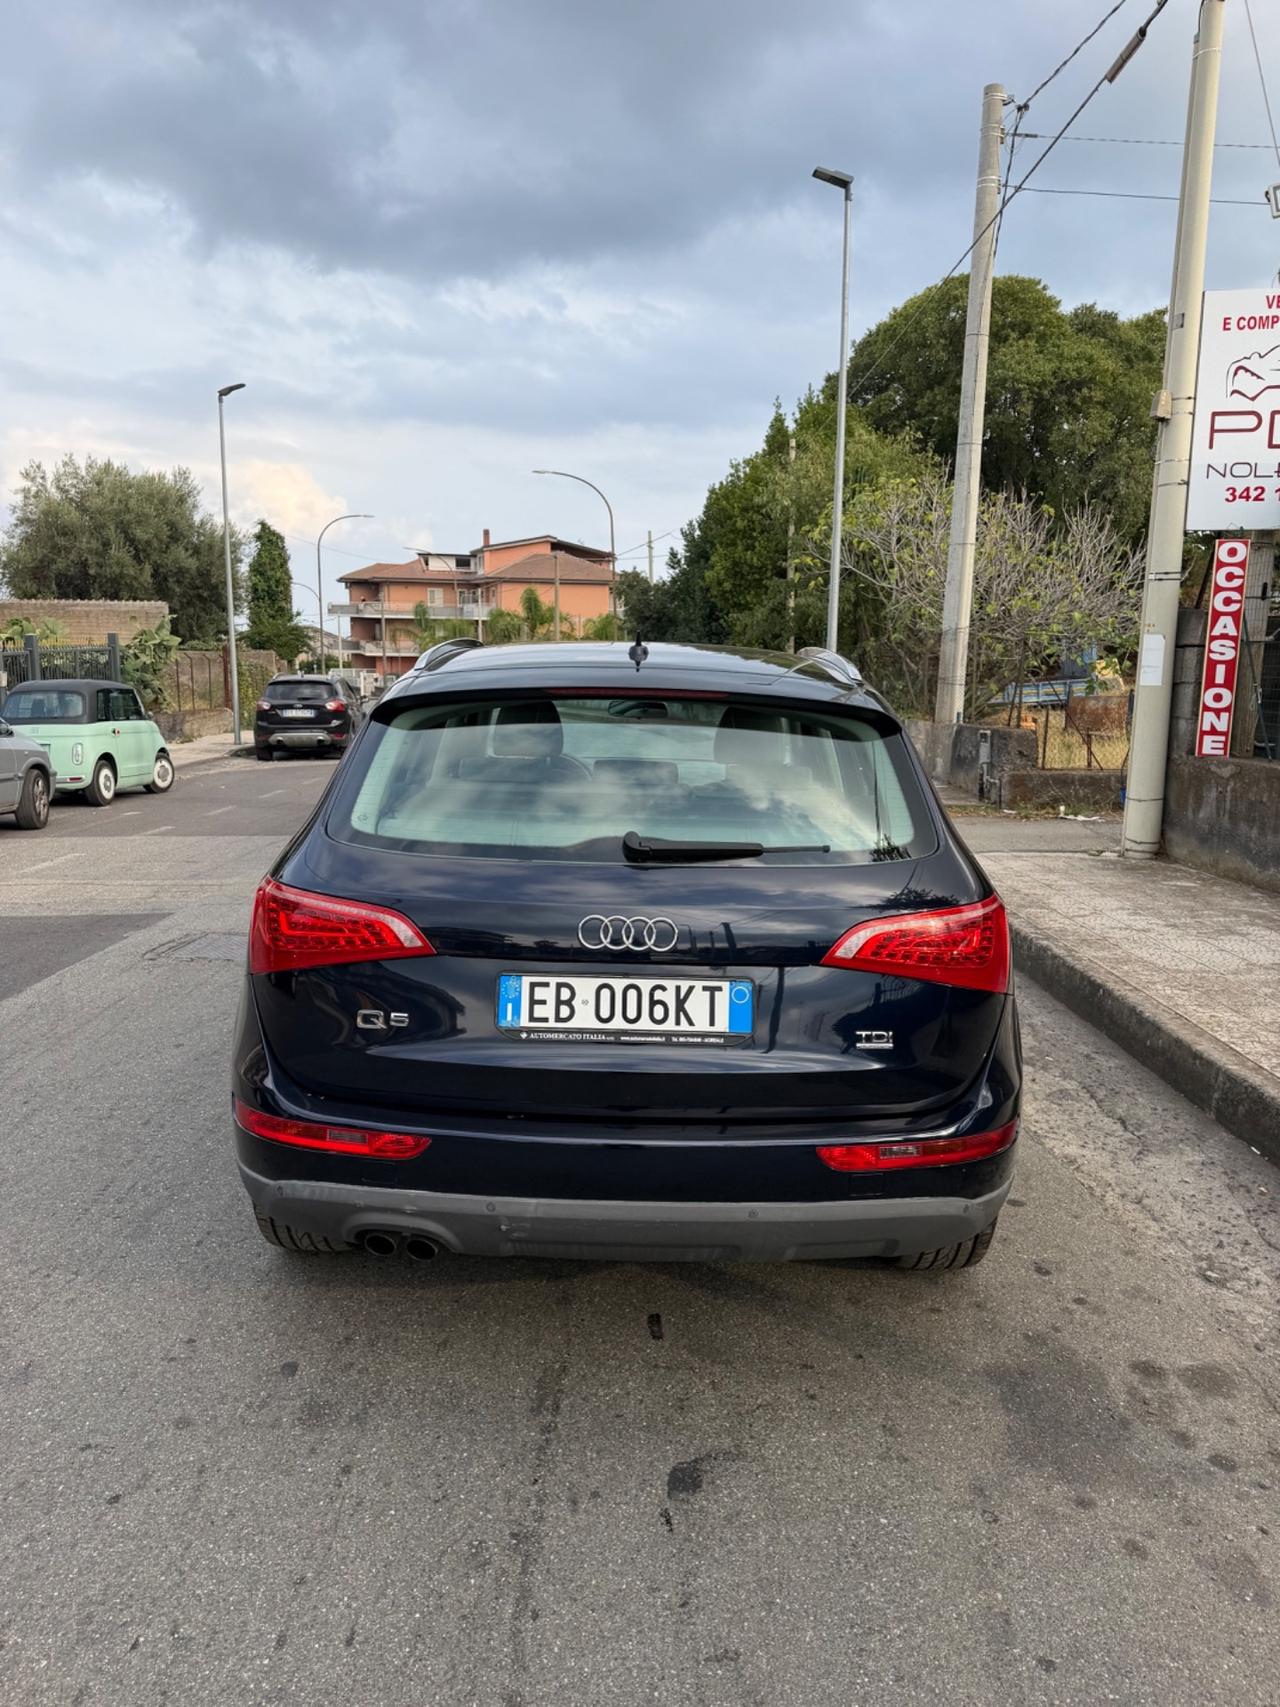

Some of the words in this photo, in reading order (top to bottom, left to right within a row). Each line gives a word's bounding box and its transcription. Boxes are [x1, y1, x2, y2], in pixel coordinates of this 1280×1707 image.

[1223, 317, 1232, 331] E
[1236, 315, 1280, 331] COMP
[1206, 462, 1280, 479] NOL
[1225, 485, 1266, 502] 342
[1202, 542, 1247, 755] OCCASIONE
[528, 981, 576, 1024] EB
[594, 983, 723, 1027] 006KT
[357, 1010, 409, 1029] Q5
[856, 1031, 893, 1043] TDI
